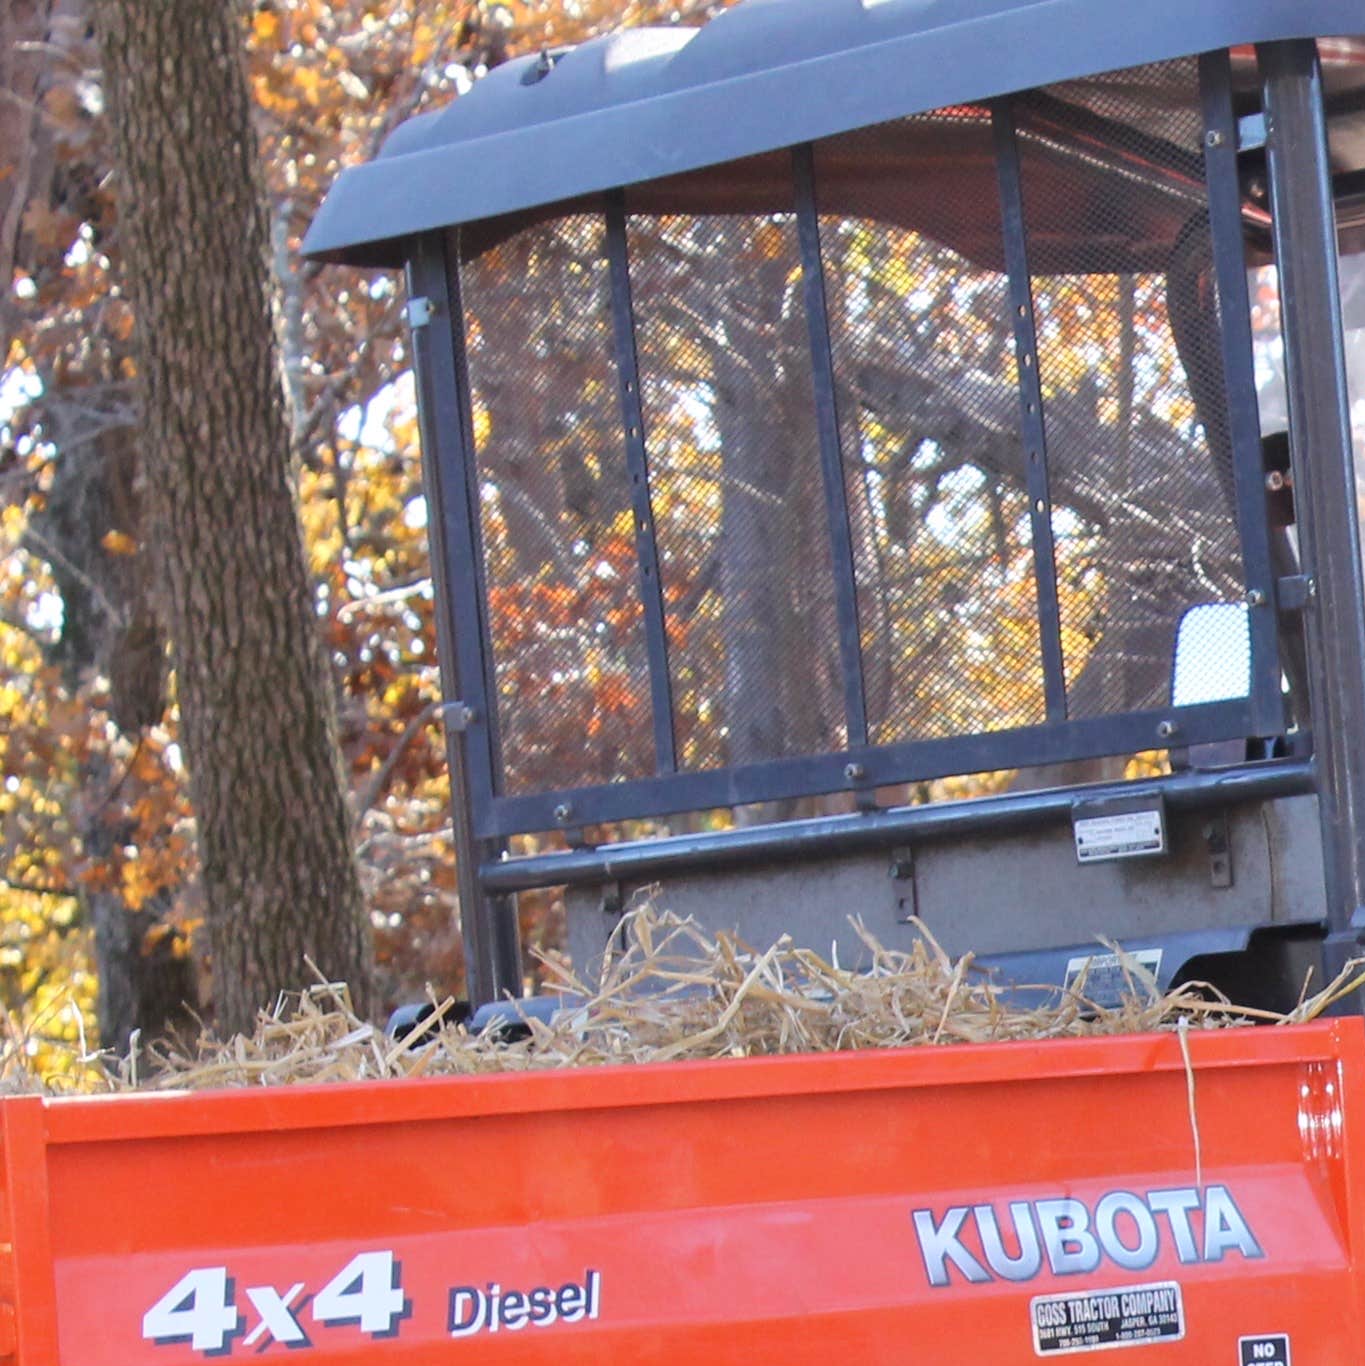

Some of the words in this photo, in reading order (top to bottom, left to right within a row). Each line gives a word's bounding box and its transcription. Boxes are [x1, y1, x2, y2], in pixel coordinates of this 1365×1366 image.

[911, 1185, 1265, 1287] KUBOTA
[142, 1249, 411, 1357] 4x4
[447, 1269, 600, 1337] Diesel
[1068, 1296, 1120, 1323] TRACTOR
[1121, 1290, 1176, 1317] COMPANY
[1252, 1342, 1276, 1359] NO
